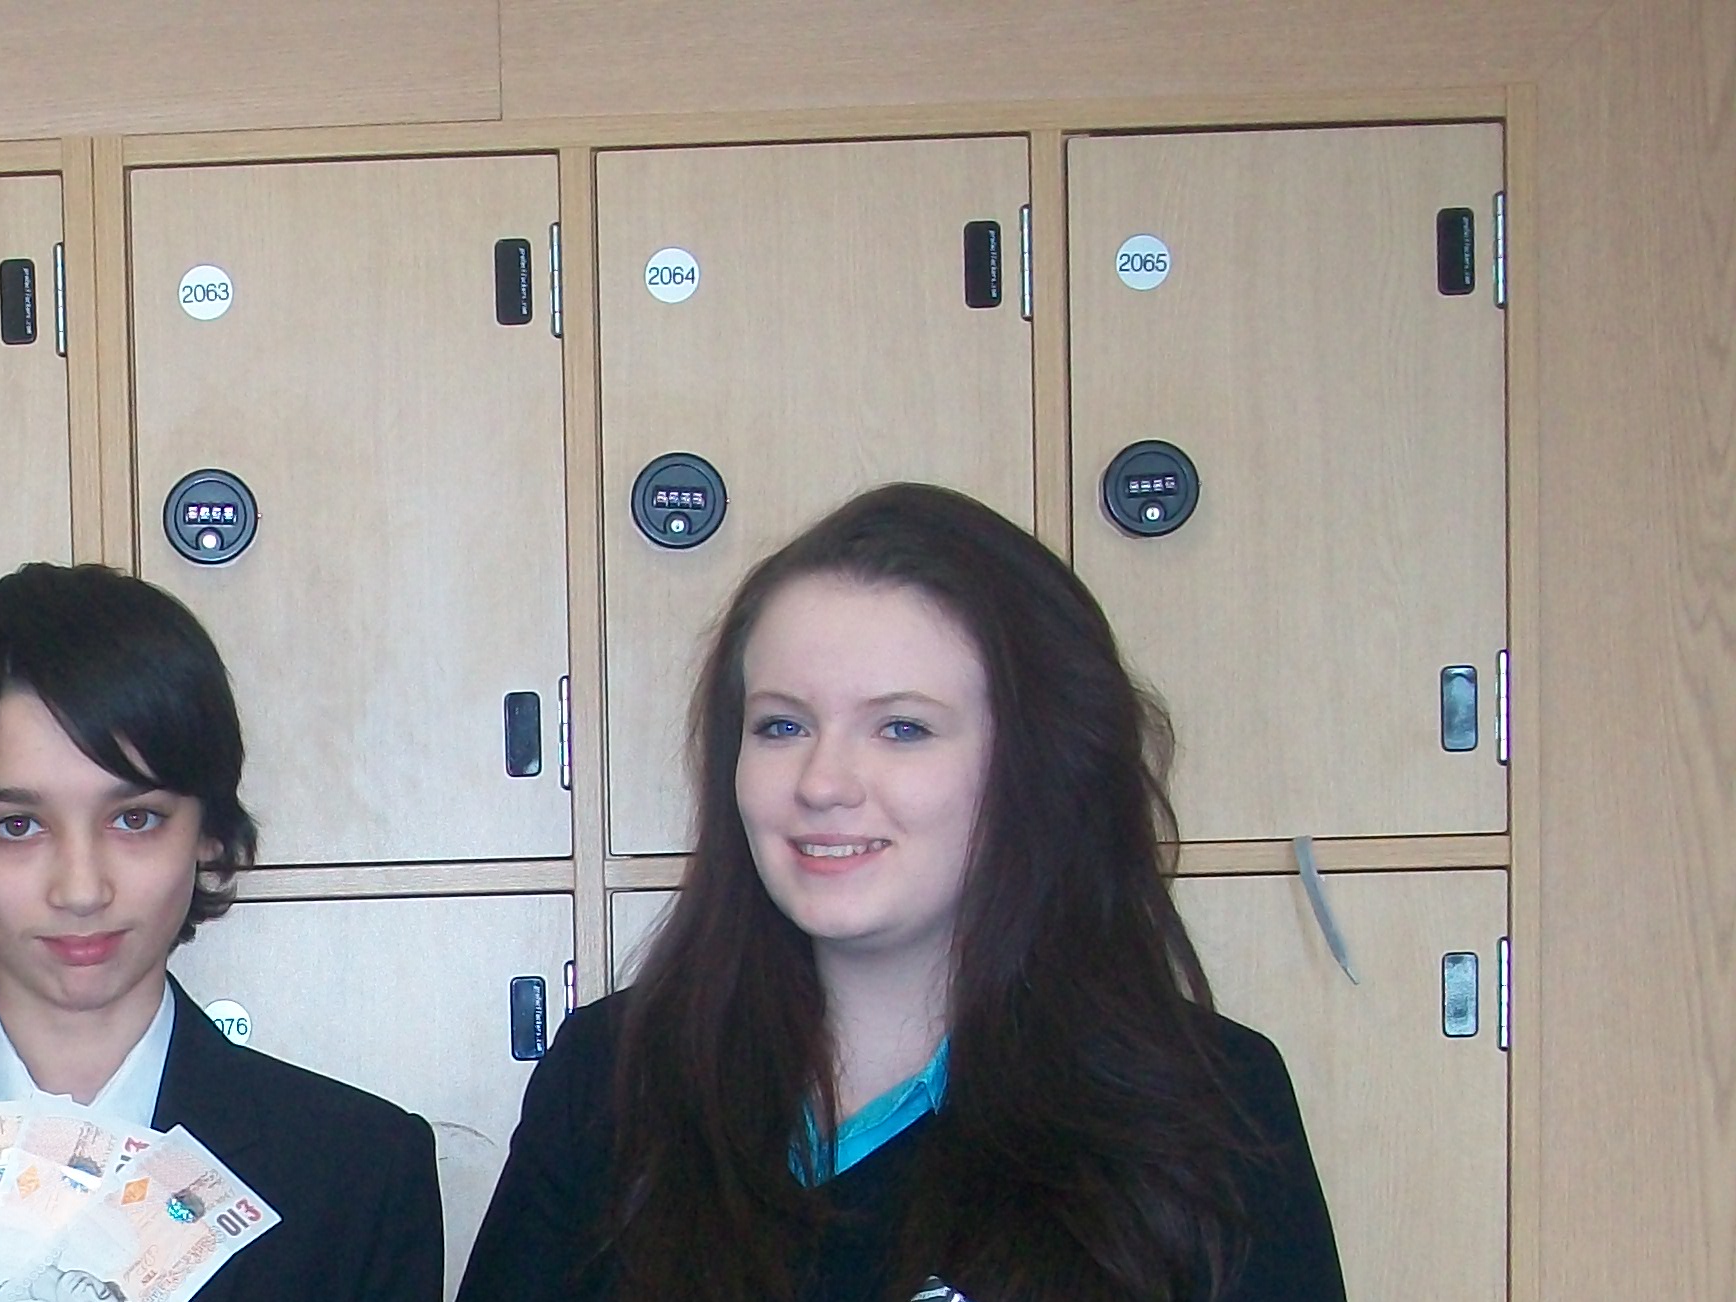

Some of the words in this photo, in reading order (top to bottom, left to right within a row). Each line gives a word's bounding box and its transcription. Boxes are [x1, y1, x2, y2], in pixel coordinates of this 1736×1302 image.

[1118, 253, 1167, 272] 2065
[648, 267, 695, 285] 2064
[182, 283, 229, 303] 2063
[214, 1018, 248, 1036] 076
